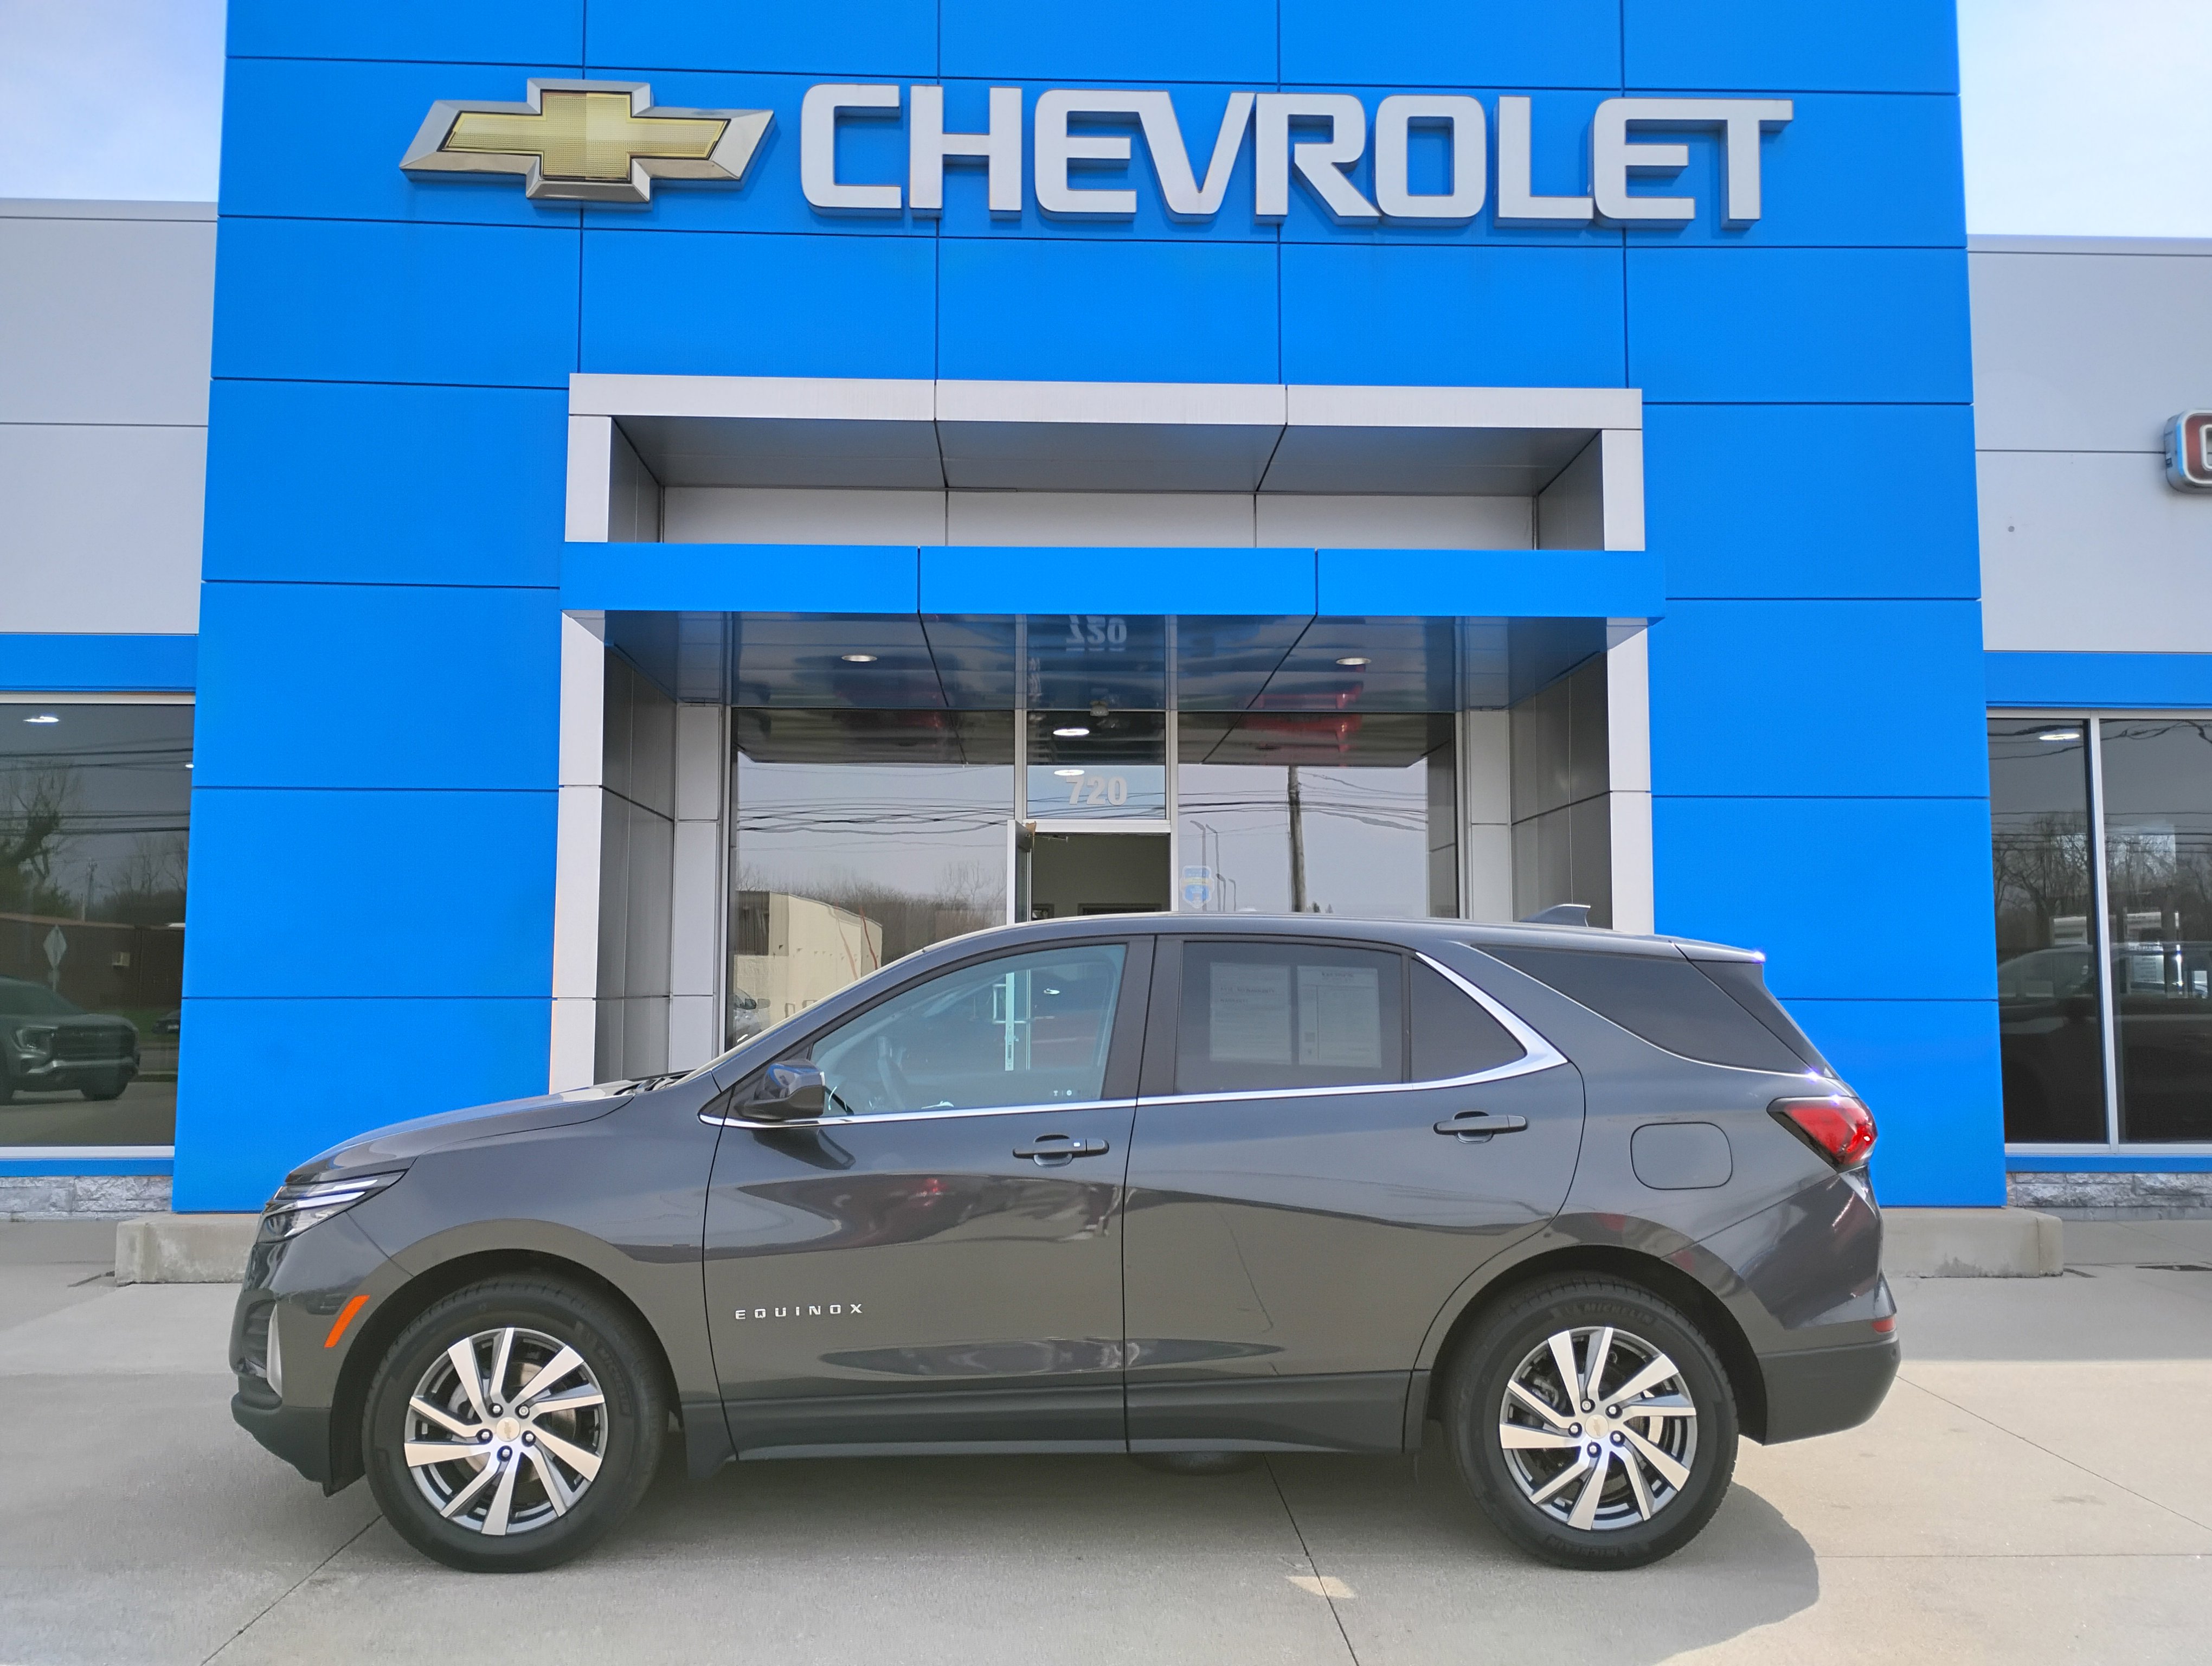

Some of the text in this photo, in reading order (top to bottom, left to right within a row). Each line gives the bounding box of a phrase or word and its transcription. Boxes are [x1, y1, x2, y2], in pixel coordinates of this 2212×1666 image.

[801, 83, 1793, 221] CHEVROLET
[1066, 776, 1127, 806] 720
[735, 1303, 863, 1320] EQUINOX
[1584, 1302, 1654, 1324] MICHELIN
